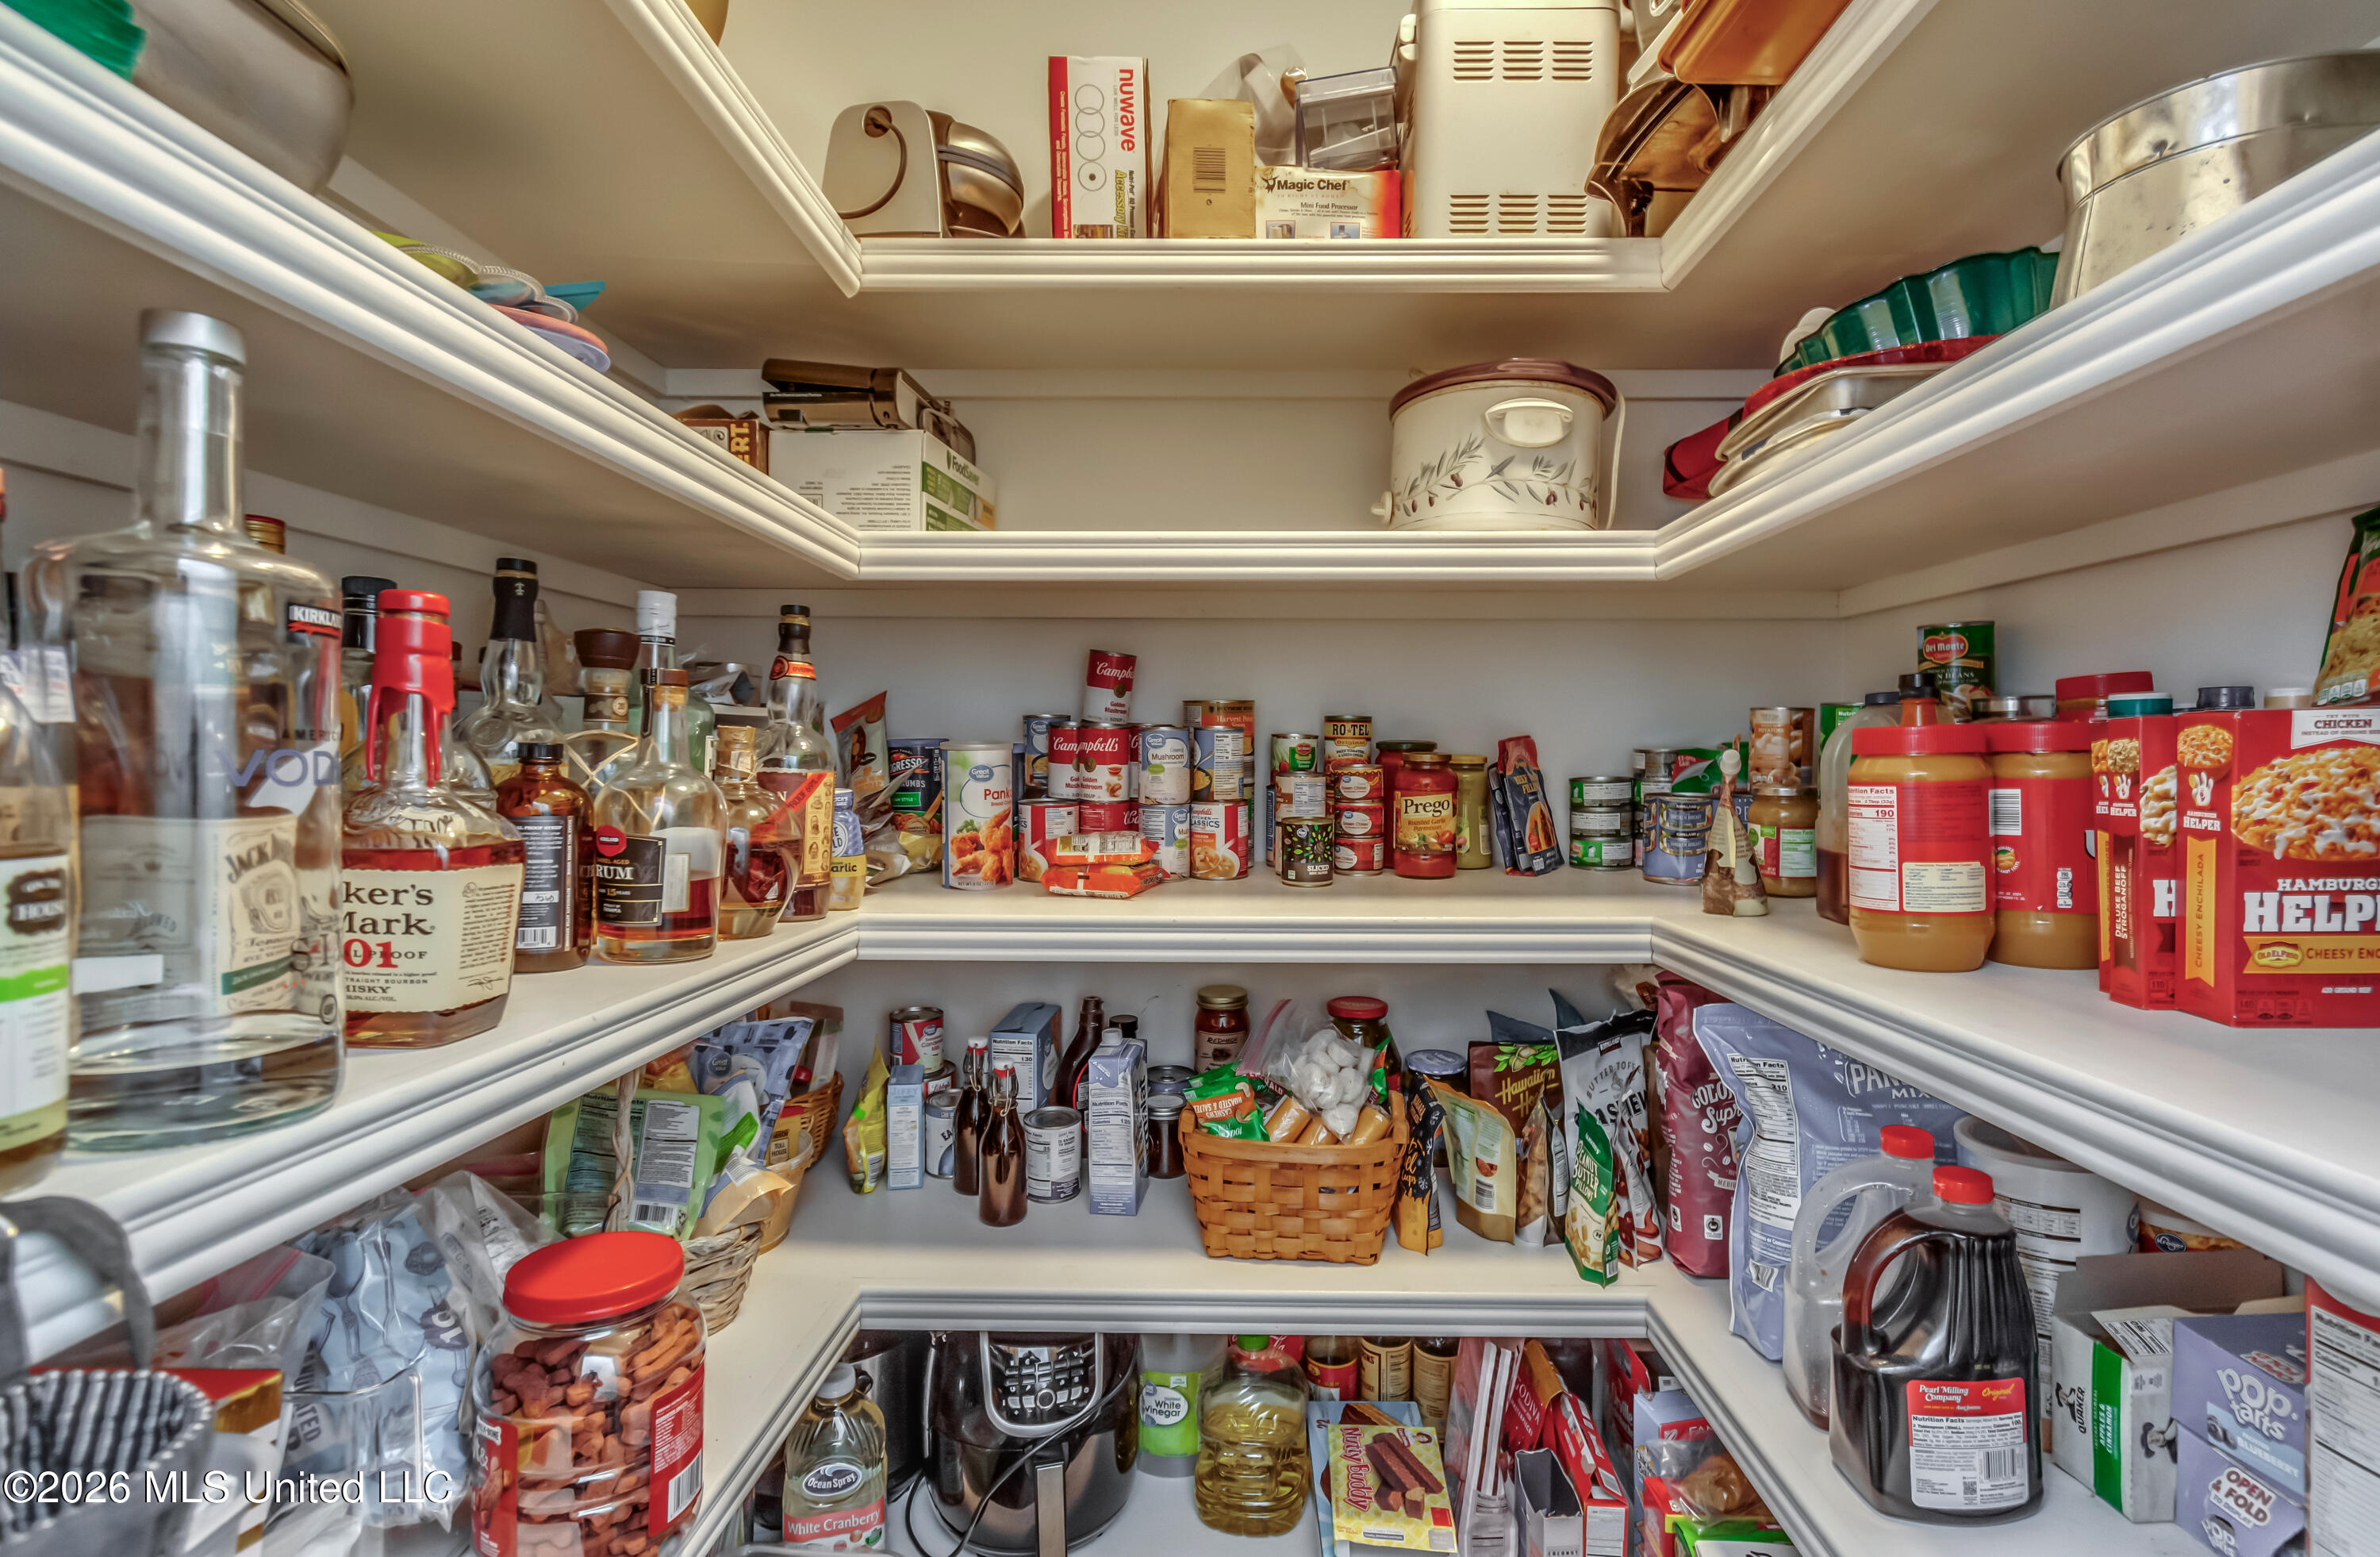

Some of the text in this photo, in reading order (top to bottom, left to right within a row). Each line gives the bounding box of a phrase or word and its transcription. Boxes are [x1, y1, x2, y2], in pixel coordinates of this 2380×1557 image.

[1119, 69, 1135, 152] nuwave
[1277, 179, 1346, 191] Magic Chef
[1115, 170, 1128, 225] Accessory
[1925, 642, 1965, 652] Del Monte
[2314, 719, 2372, 729] CHICKEN
[1079, 738, 1118, 753] mpbell's
[1403, 798, 1449, 817] Prego
[2110, 807, 2136, 817] HELPER
[2183, 817, 2221, 831] HELPER
[596, 864, 634, 880] RUM
[831, 863, 857, 872] arlic
[343, 882, 433, 905] ker's
[343, 938, 398, 968] 01
[2306, 948, 2380, 959] CHEESY ENC
[346, 985, 390, 994] HISKY
[1599, 1037, 1621, 1051] KIRKLAND
[1495, 1069, 1556, 1105] Hawaiian
[1587, 1065, 1614, 1099] BUTTER
[1850, 1063, 1902, 1094] PAN
[1219, 1097, 1242, 1109] ROASTED
[1512, 1090, 1537, 1117] Ho
[1691, 1080, 1733, 1109] COLO
[1205, 1108, 1232, 1119] CASHEWS
[1702, 1104, 1744, 1134] Supr
[1576, 1140, 1599, 1174] PEANUT
[1573, 1159, 1599, 1198] BUTTER
[1718, 1178, 1737, 1188] MEDIU
[1575, 1181, 1594, 1201] PILLOWS
[2316, 1312, 2361, 1340] Nutrition
[1919, 1383, 2015, 1401] Pearl Milling Original
[1925, 1393, 1961, 1403] Company
[1144, 1405, 1180, 1418] Vinegar
[1154, 1400, 1180, 1409] White
[2076, 1387, 2086, 1434] QUAKER
[2230, 1397, 2286, 1440] tarts
[2237, 1436, 2298, 1478] BLUEBERRY
[1340, 1427, 1374, 1512] Nutty Buddy
[808, 1472, 858, 1491] Ocean Spray
[2227, 1470, 2273, 1506] OPEN
[2212, 1480, 2267, 1523] & FOLD
[788, 1509, 881, 1535] White Cranberry
